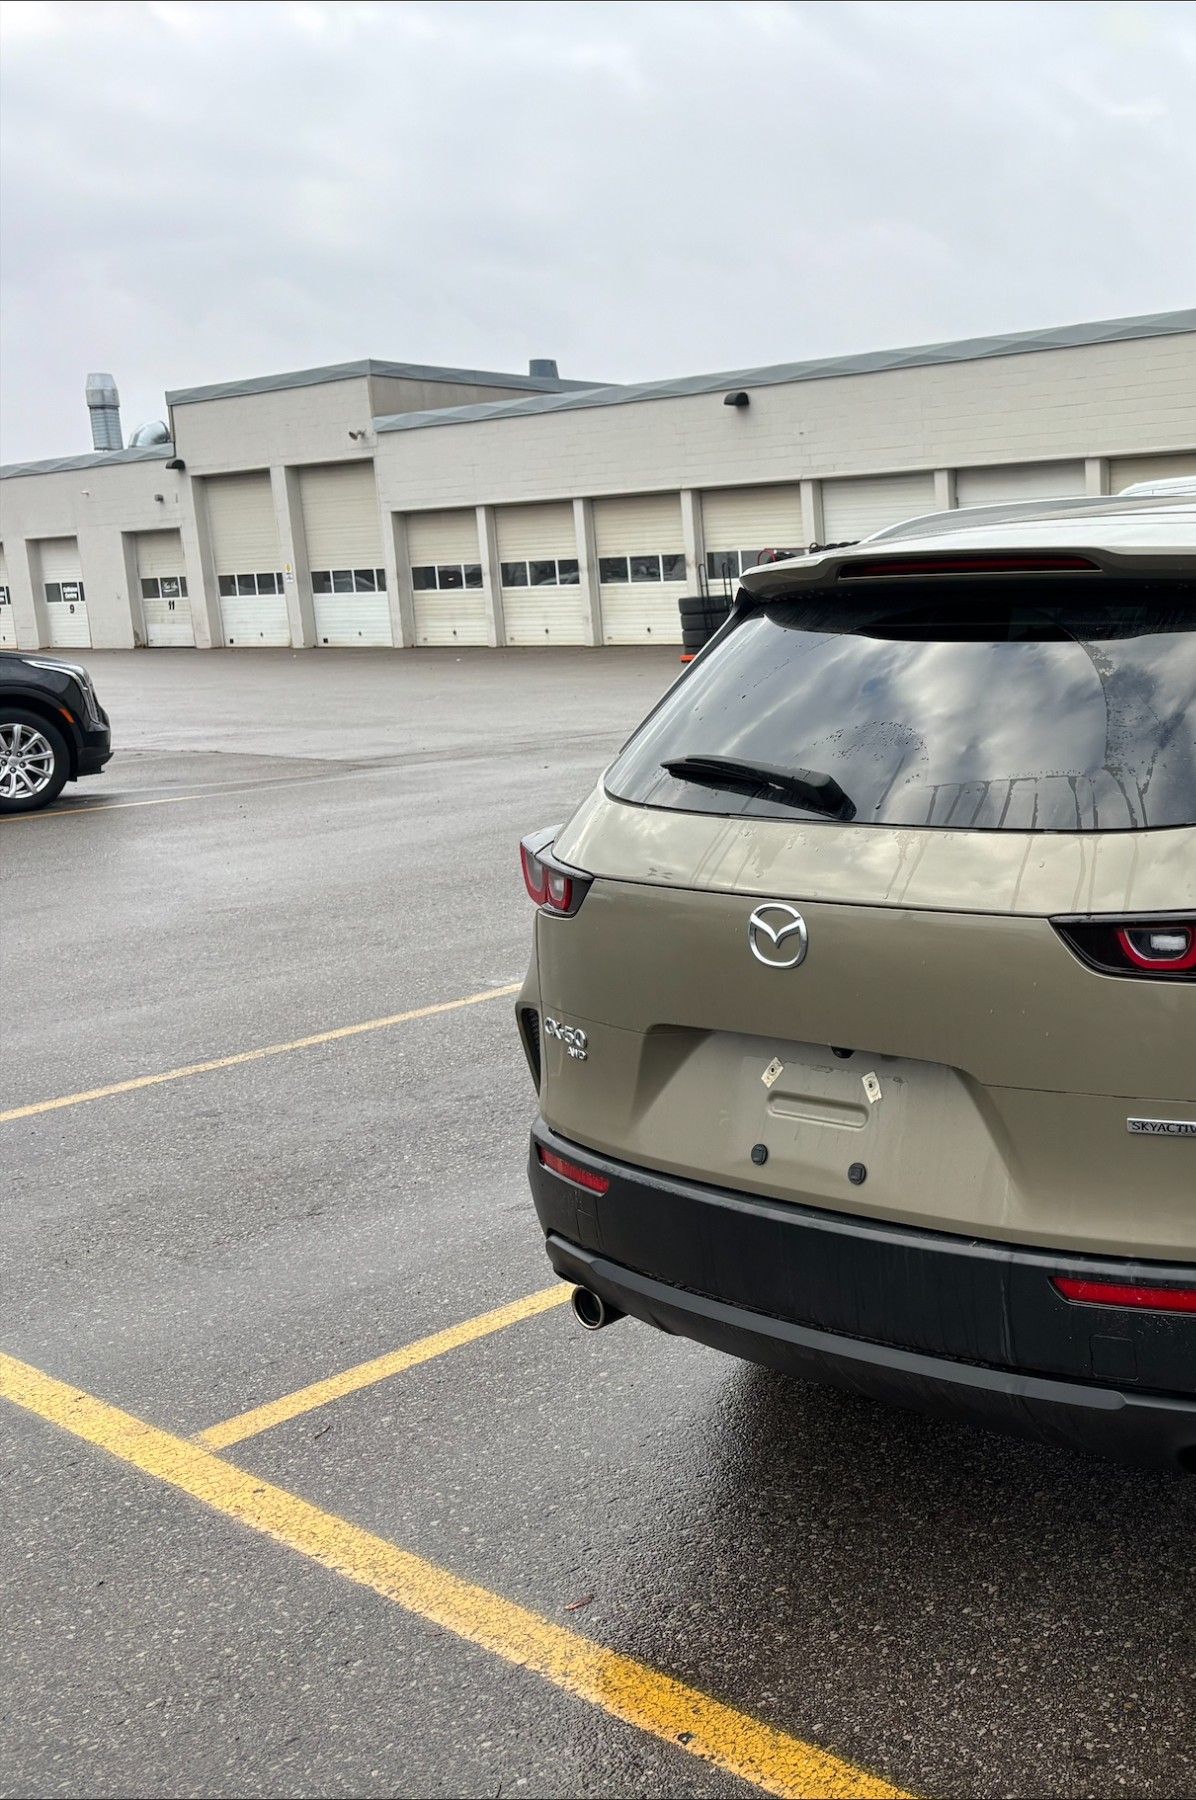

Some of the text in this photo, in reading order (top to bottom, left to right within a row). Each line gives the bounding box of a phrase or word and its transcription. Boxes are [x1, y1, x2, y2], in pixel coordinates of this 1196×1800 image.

[69, 604, 75, 614] 9
[168, 600, 175, 610] 11
[544, 1016, 586, 1048] CX-50
